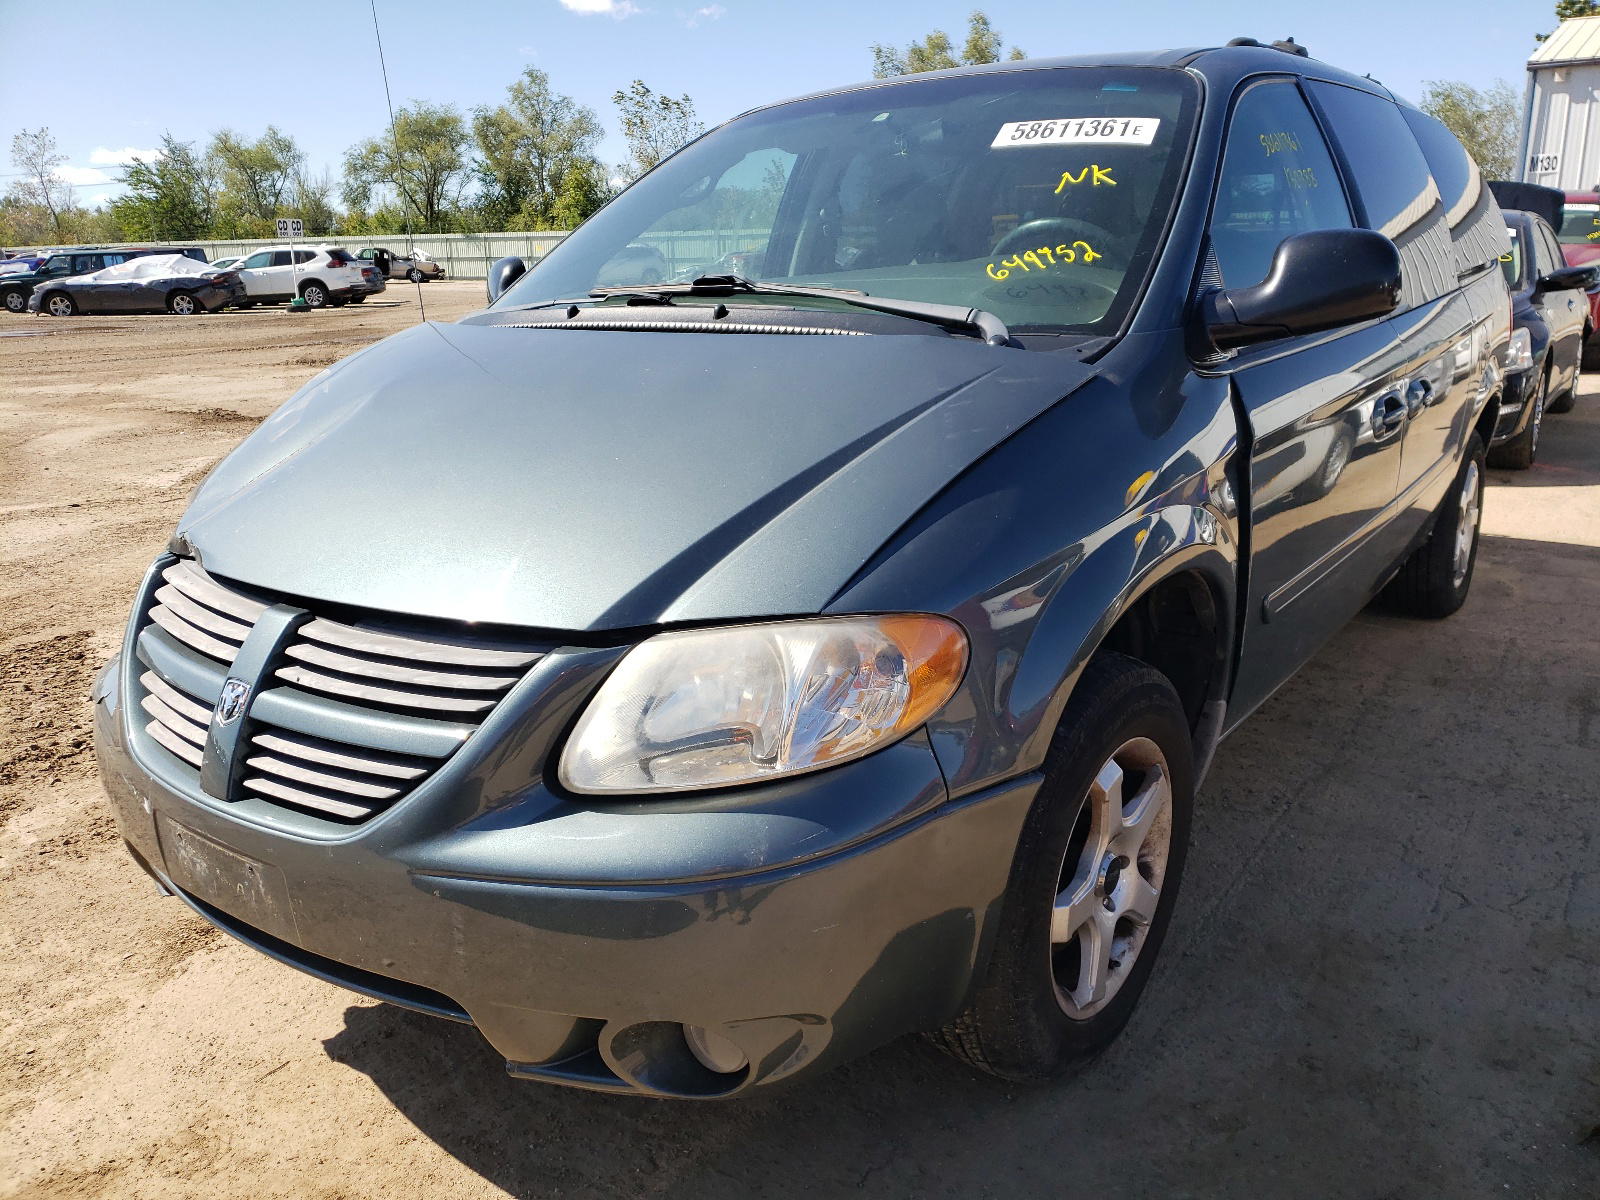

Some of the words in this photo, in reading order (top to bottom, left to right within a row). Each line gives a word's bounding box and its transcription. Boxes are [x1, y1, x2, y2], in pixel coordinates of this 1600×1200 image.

[1529, 155, 1558, 172] M130
[278, 220, 288, 230] CD
[292, 220, 301, 231] CD
